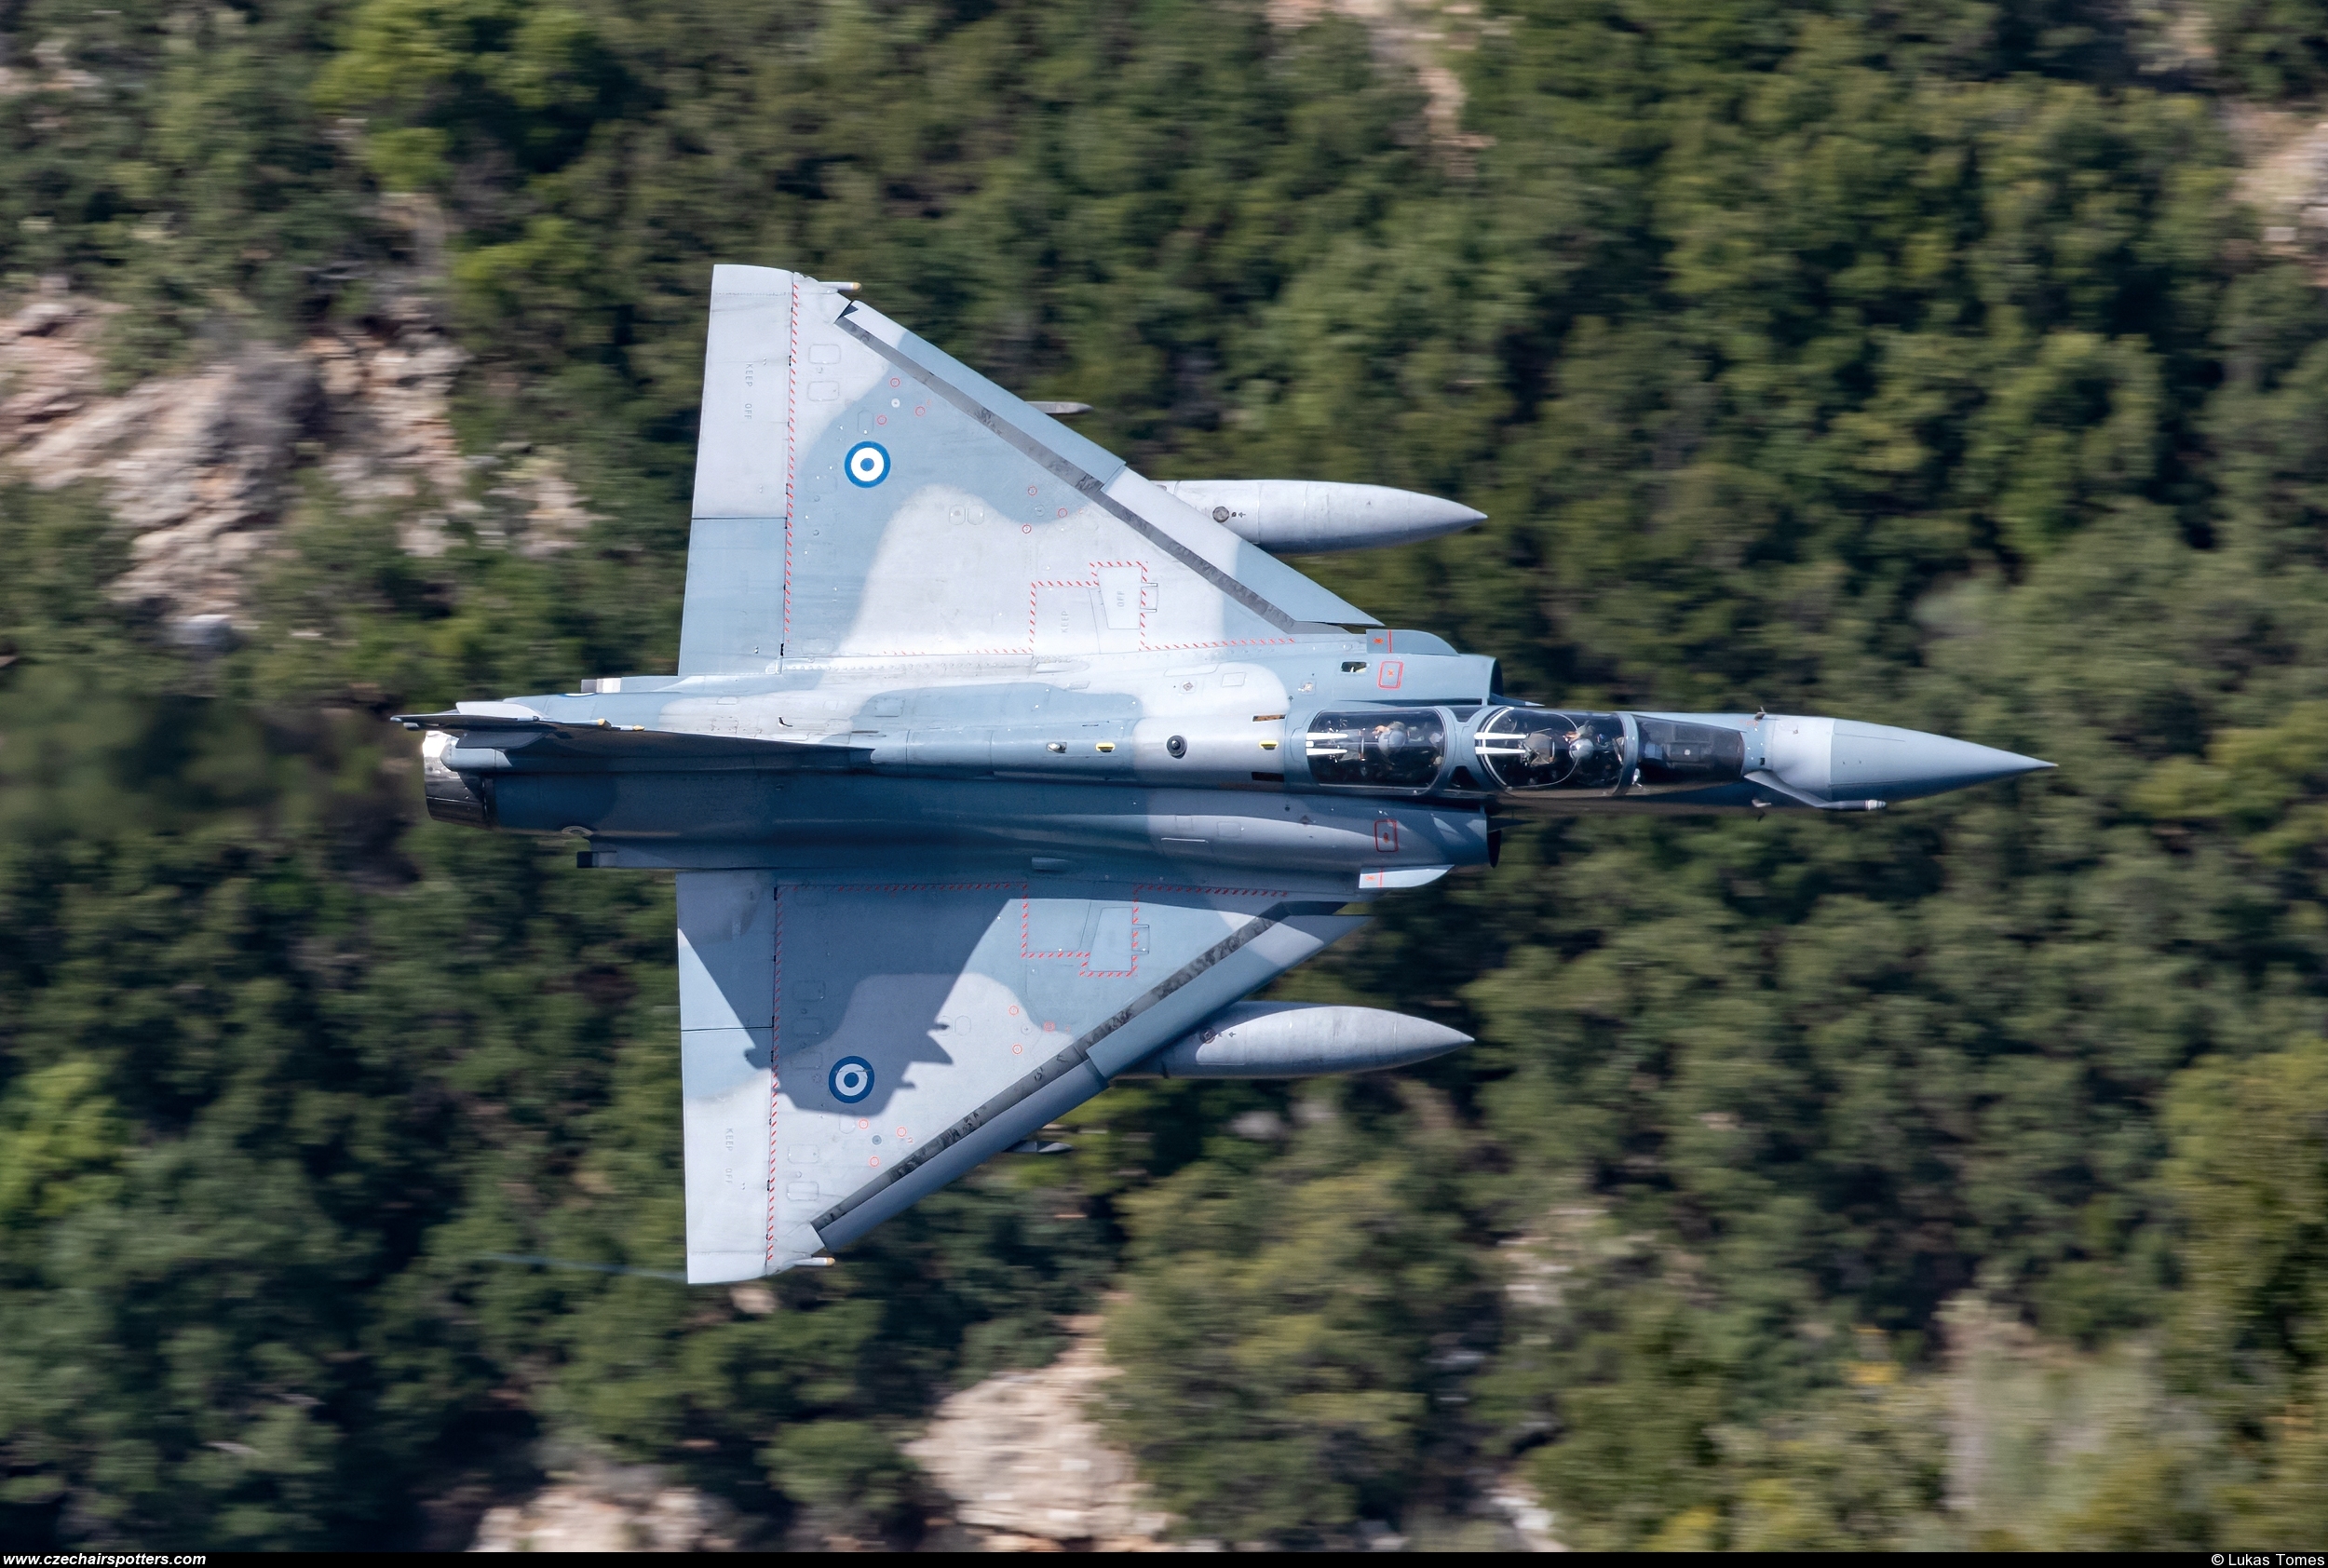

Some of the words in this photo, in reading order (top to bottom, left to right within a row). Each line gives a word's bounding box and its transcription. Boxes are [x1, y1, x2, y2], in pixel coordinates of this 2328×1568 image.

[745, 363, 753, 387] KEEP
[744, 403, 752, 420] OFF
[1061, 610, 1070, 633] KEEP
[1117, 590, 1125, 608] OFF
[725, 1128, 734, 1152] KEEP
